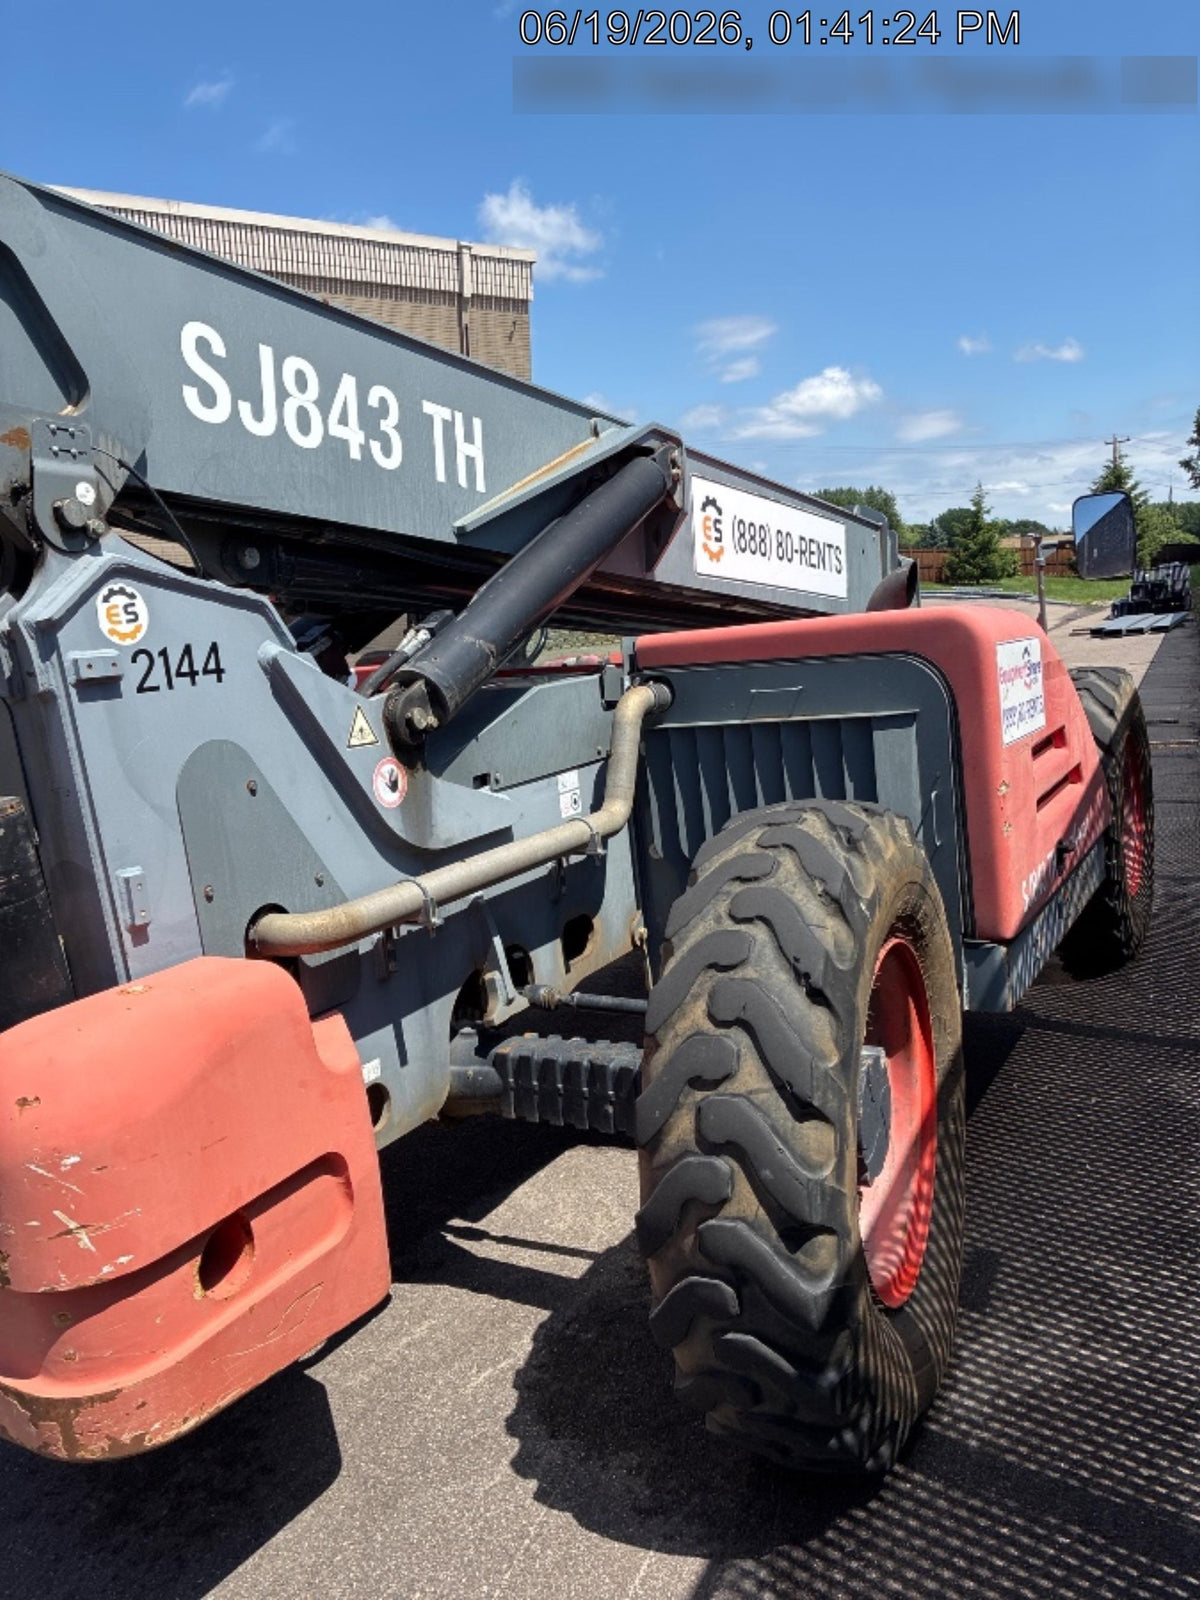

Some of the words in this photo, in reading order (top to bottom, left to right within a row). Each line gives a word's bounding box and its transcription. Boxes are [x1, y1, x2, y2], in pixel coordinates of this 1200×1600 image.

[180, 320, 403, 471] SJ843
[422, 400, 487, 493] TH
[702, 515, 723, 543] ES
[732, 515, 773, 562] (888)
[776, 529, 843, 575] 80-RENTS
[105, 602, 139, 626] ES
[131, 641, 226, 694] 2144
